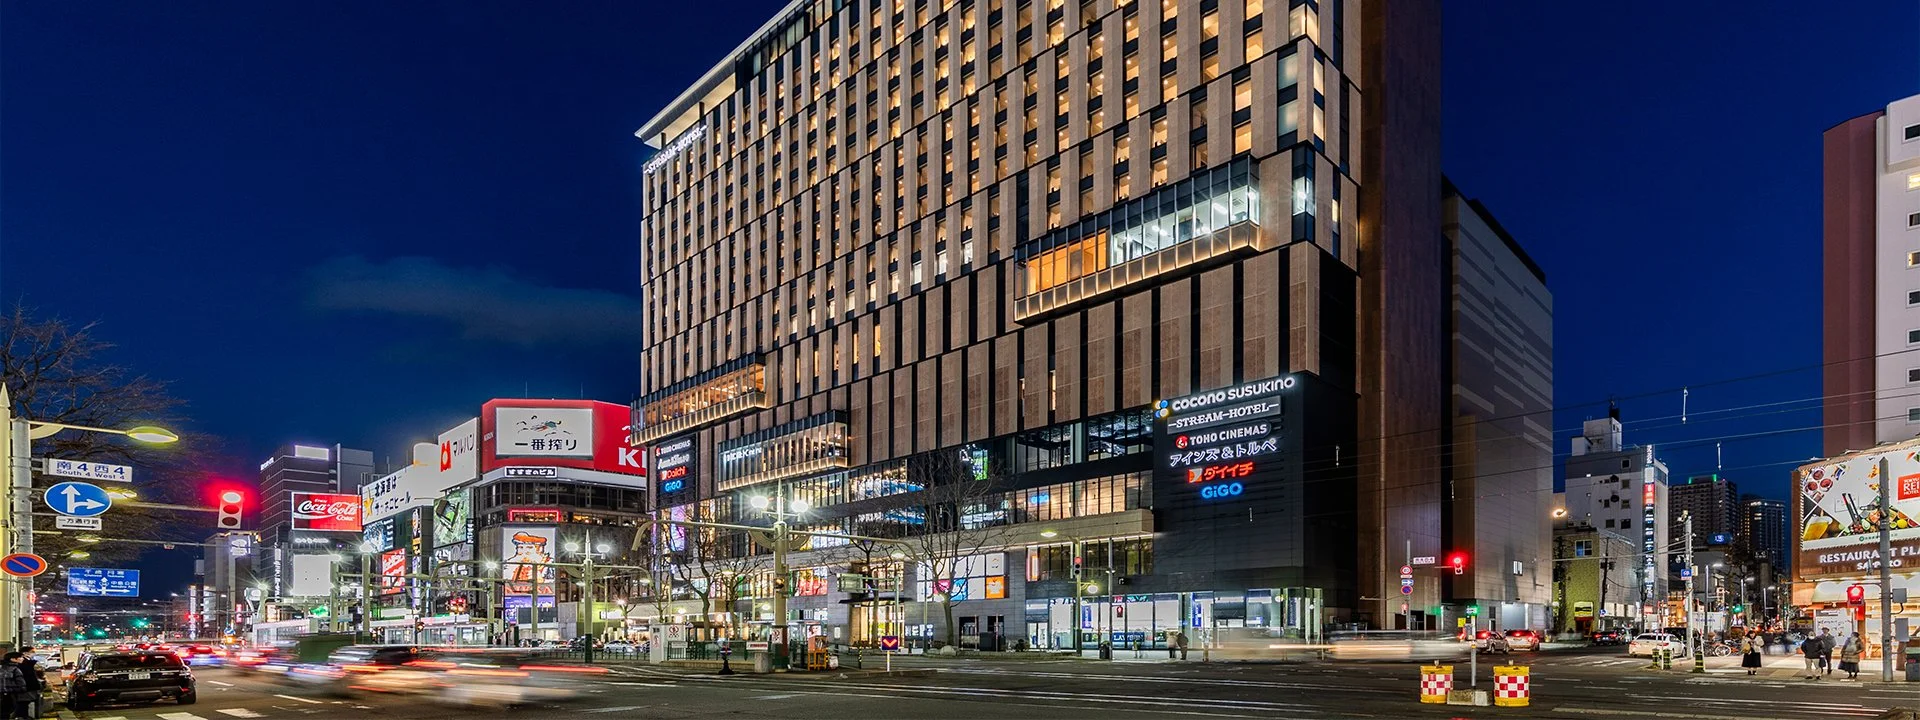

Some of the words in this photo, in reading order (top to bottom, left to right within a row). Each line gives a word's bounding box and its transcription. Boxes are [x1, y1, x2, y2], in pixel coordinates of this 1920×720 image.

[1190, 434, 1218, 446] TOHO
[1219, 424, 1267, 440] CINEMAS
[515, 438, 577, 451] 一番搾り
[1204, 462, 1254, 481] ダイイチ
[1201, 482, 1243, 499] GiGO
[1903, 481, 1920, 492] REI
[1819, 547, 1898, 563] RESTAURAT
